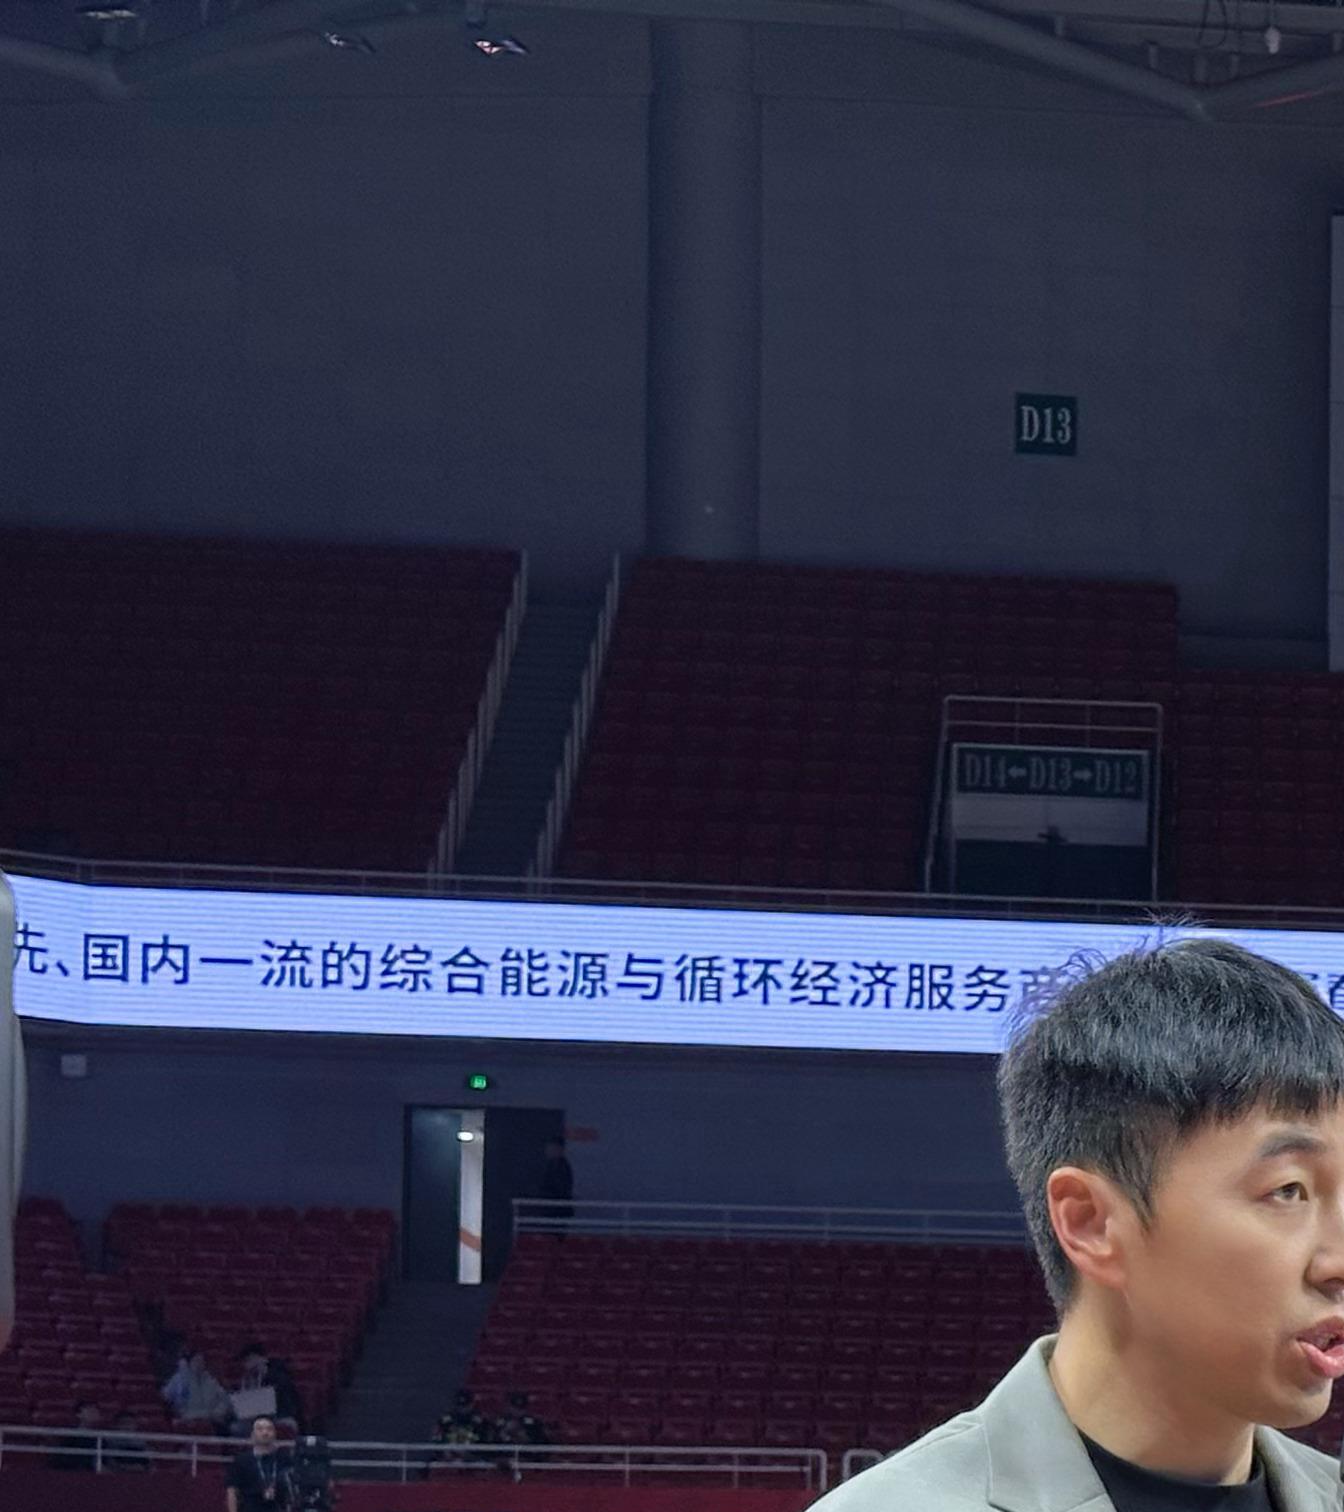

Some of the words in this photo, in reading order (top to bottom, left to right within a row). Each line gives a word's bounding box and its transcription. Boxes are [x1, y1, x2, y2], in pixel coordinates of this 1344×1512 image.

[1020, 404, 1072, 445] D13
[1029, 756, 1073, 791] D13
[1093, 759, 1138, 794] D12
